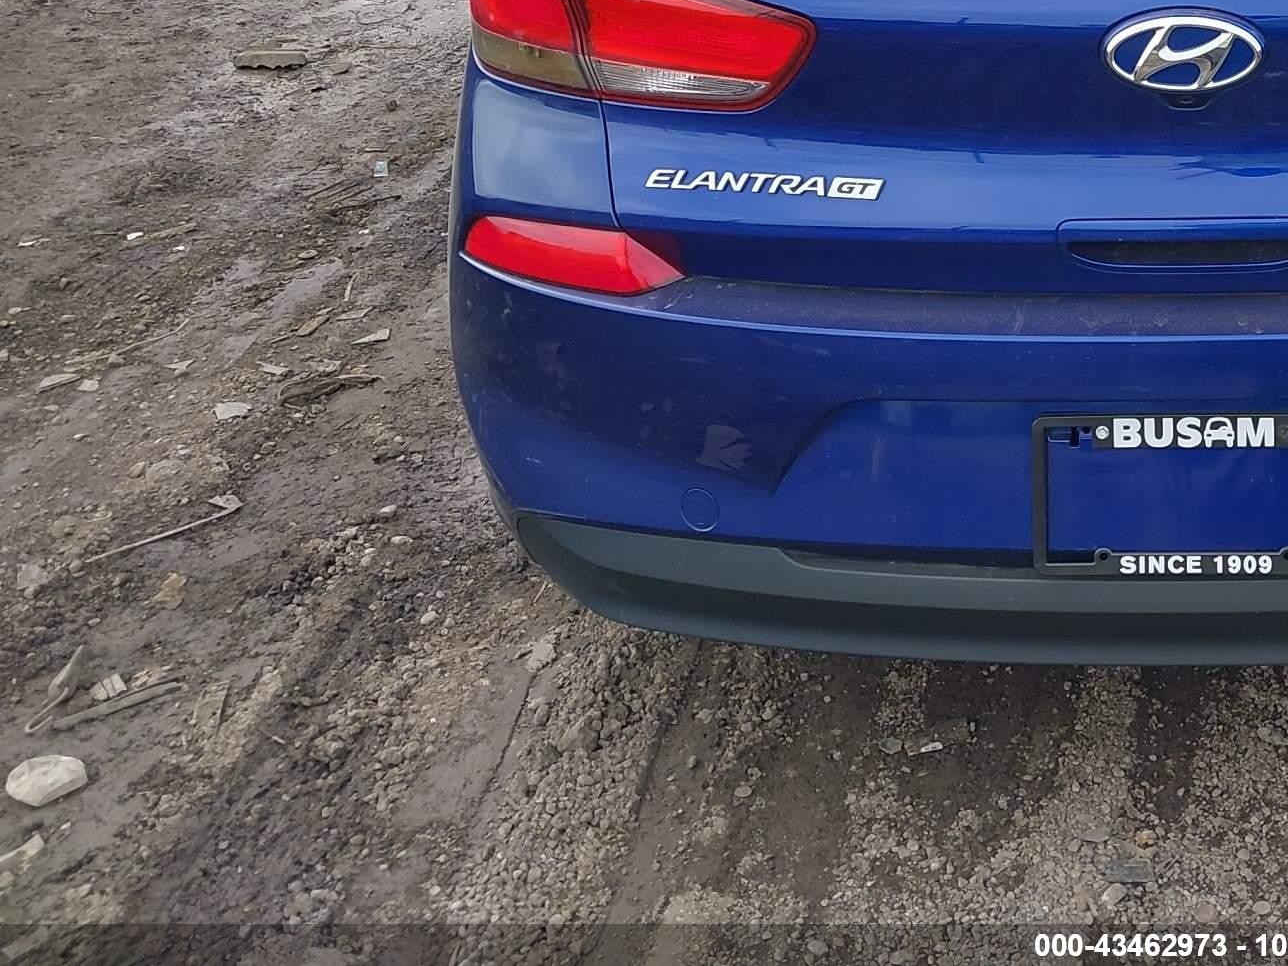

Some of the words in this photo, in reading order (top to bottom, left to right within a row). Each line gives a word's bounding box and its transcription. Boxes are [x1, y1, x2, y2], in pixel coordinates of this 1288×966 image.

[644, 168, 826, 197] ELANTRA
[835, 180, 879, 196] GT
[1119, 555, 1203, 575] SINCE
[1213, 555, 1273, 575] 1909
